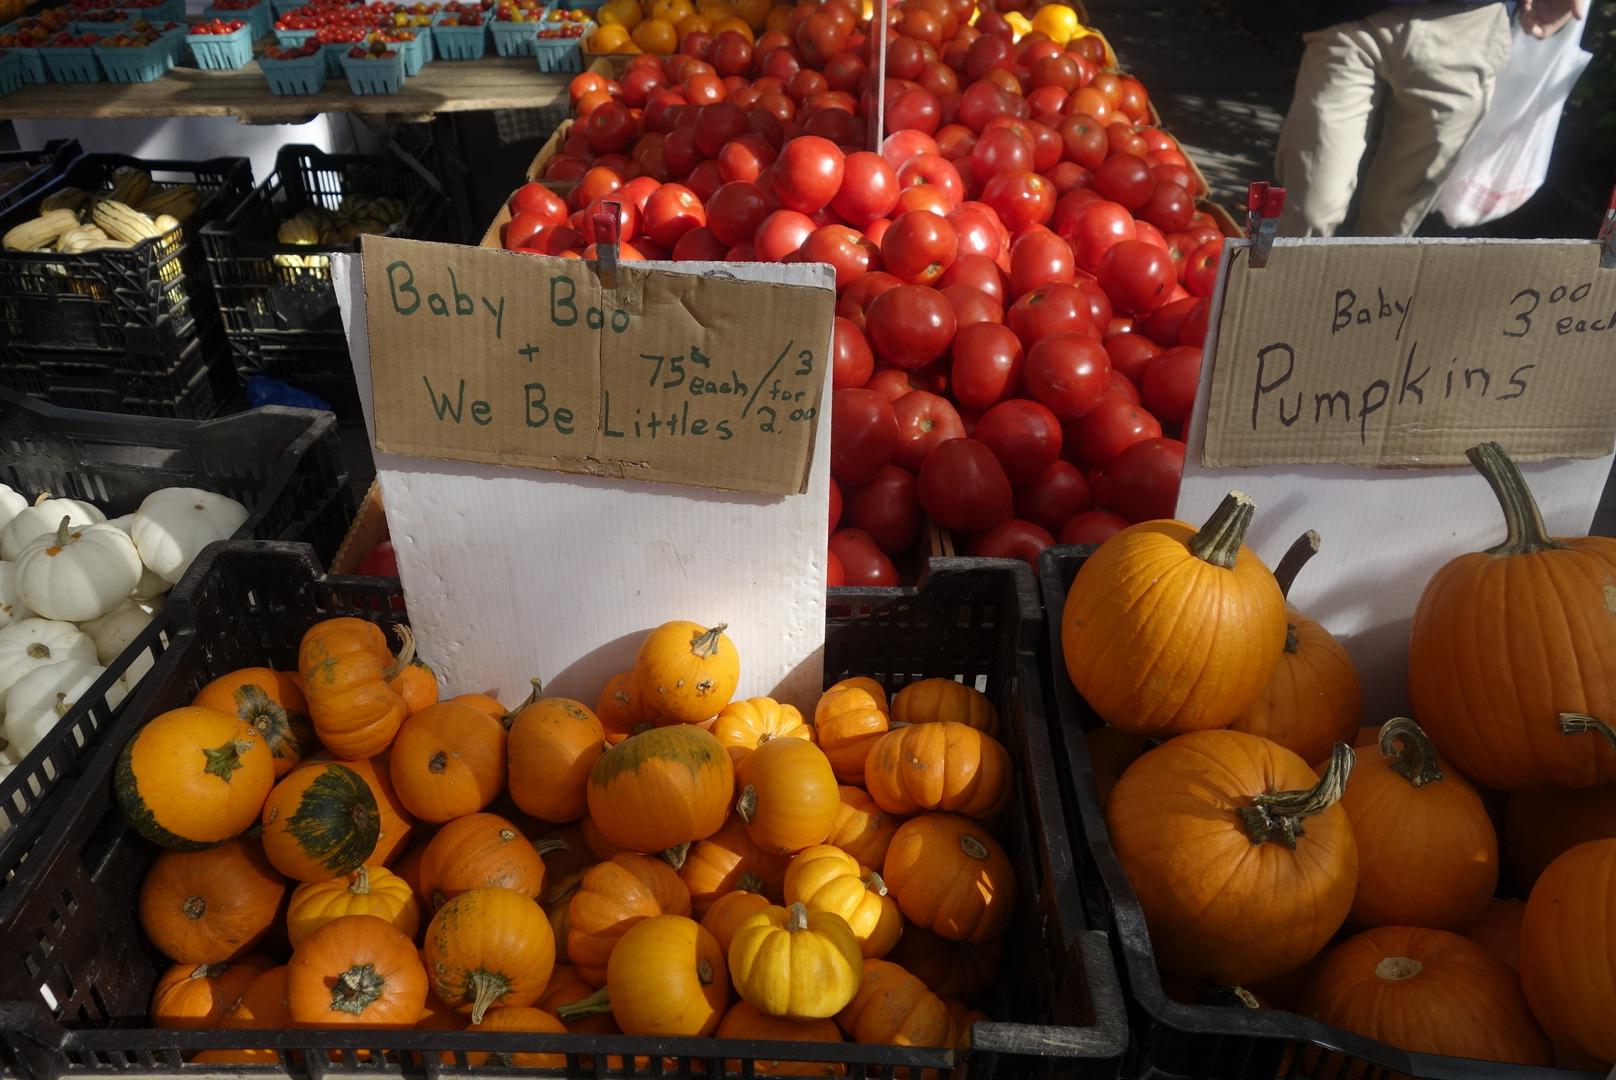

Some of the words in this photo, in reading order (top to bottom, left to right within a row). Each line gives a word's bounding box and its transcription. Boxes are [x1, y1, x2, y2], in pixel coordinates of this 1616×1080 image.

[385, 260, 505, 339] Baby
[549, 275, 631, 334] Boo
[1331, 287, 1413, 341] Baby
[518, 341, 540, 363] +
[795, 350, 814, 376] 3
[689, 370, 749, 397] each
[769, 379, 806, 402] for
[1252, 341, 1536, 446] Pumpkins
[422, 375, 493, 426] We
[523, 382, 576, 435] Be
[602, 391, 734, 441] Littles
